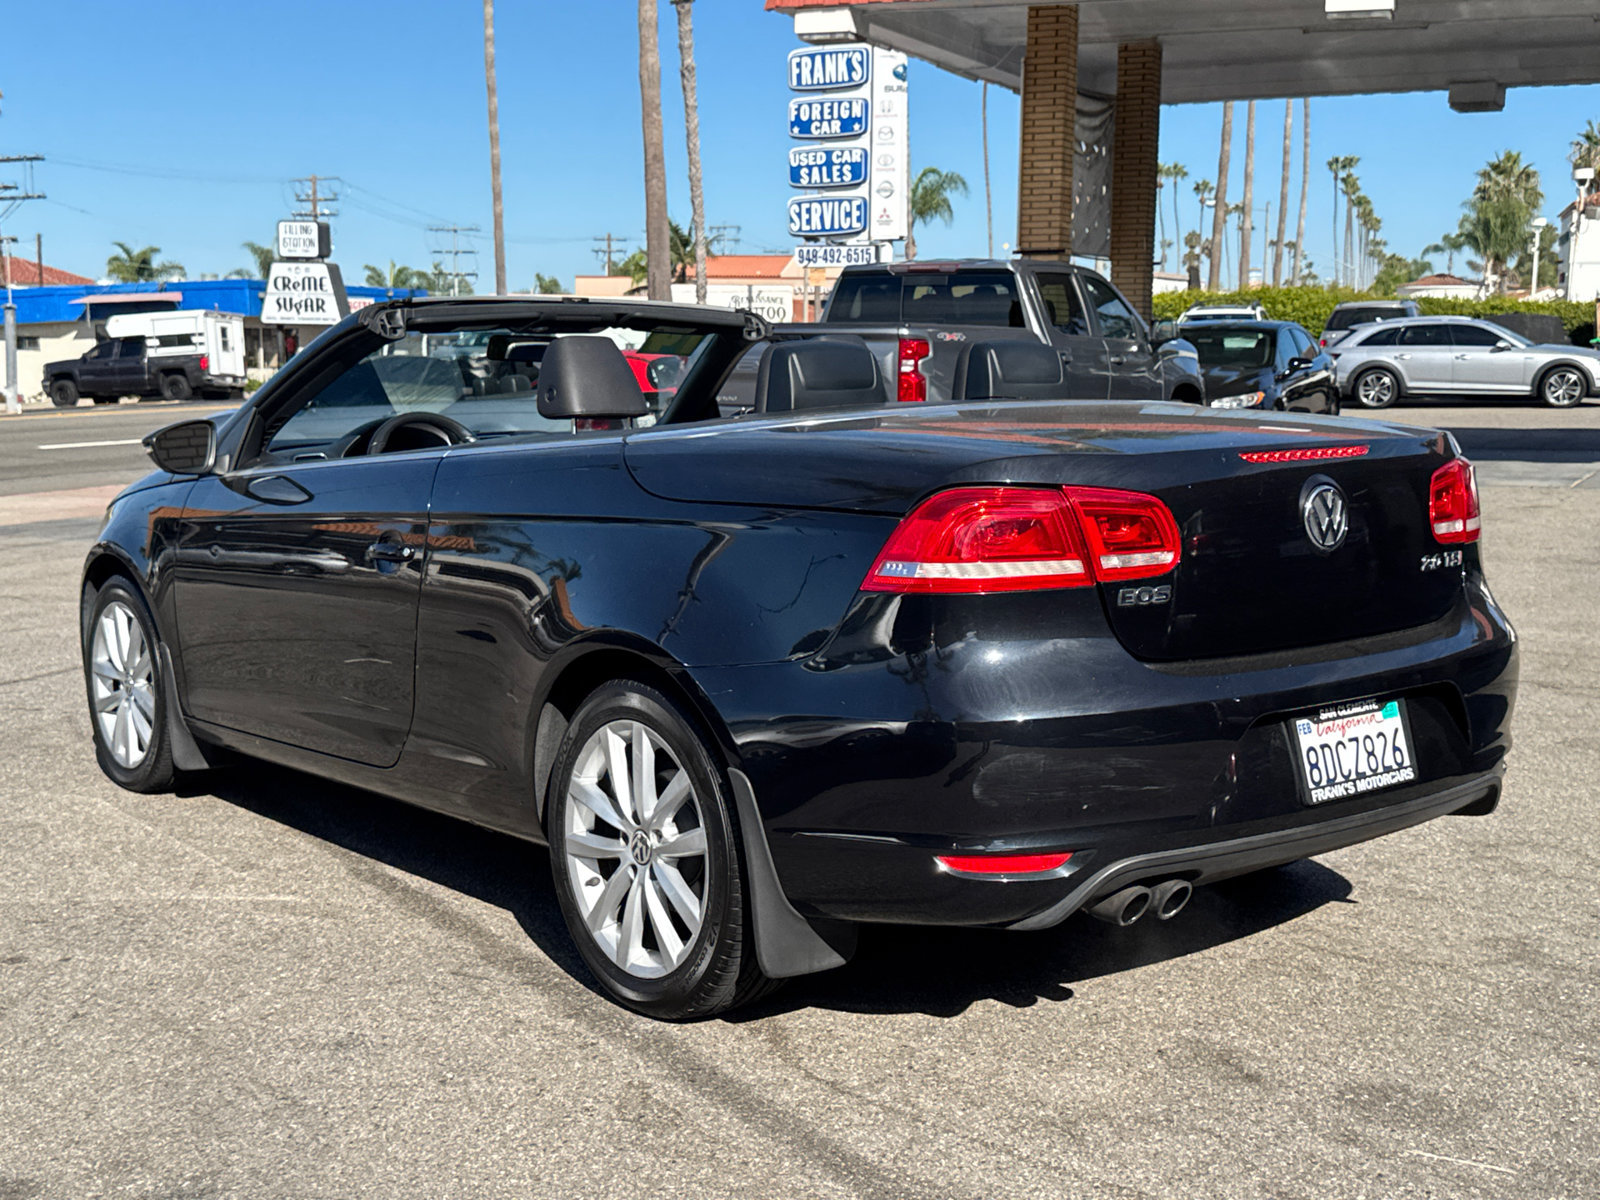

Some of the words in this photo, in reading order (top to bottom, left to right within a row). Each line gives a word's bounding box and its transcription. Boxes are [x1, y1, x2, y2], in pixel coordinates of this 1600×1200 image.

[790, 50, 863, 86] FRANK'S
[790, 101, 862, 122] FOREIGN
[810, 120, 841, 135] CAR
[790, 152, 827, 167] USED
[831, 150, 862, 165] CAR
[800, 165, 852, 185] SALES
[790, 201, 862, 232] SERVICE
[798, 248, 872, 264] 949-492-6515
[1117, 584, 1172, 607] EOS
[1298, 722, 1312, 735] FEB
[1316, 713, 1384, 737] California
[1306, 727, 1404, 787] 8DCZ826
[1311, 781, 1355, 802] FRANK'S
[1356, 767, 1415, 792] MOTORCARS
